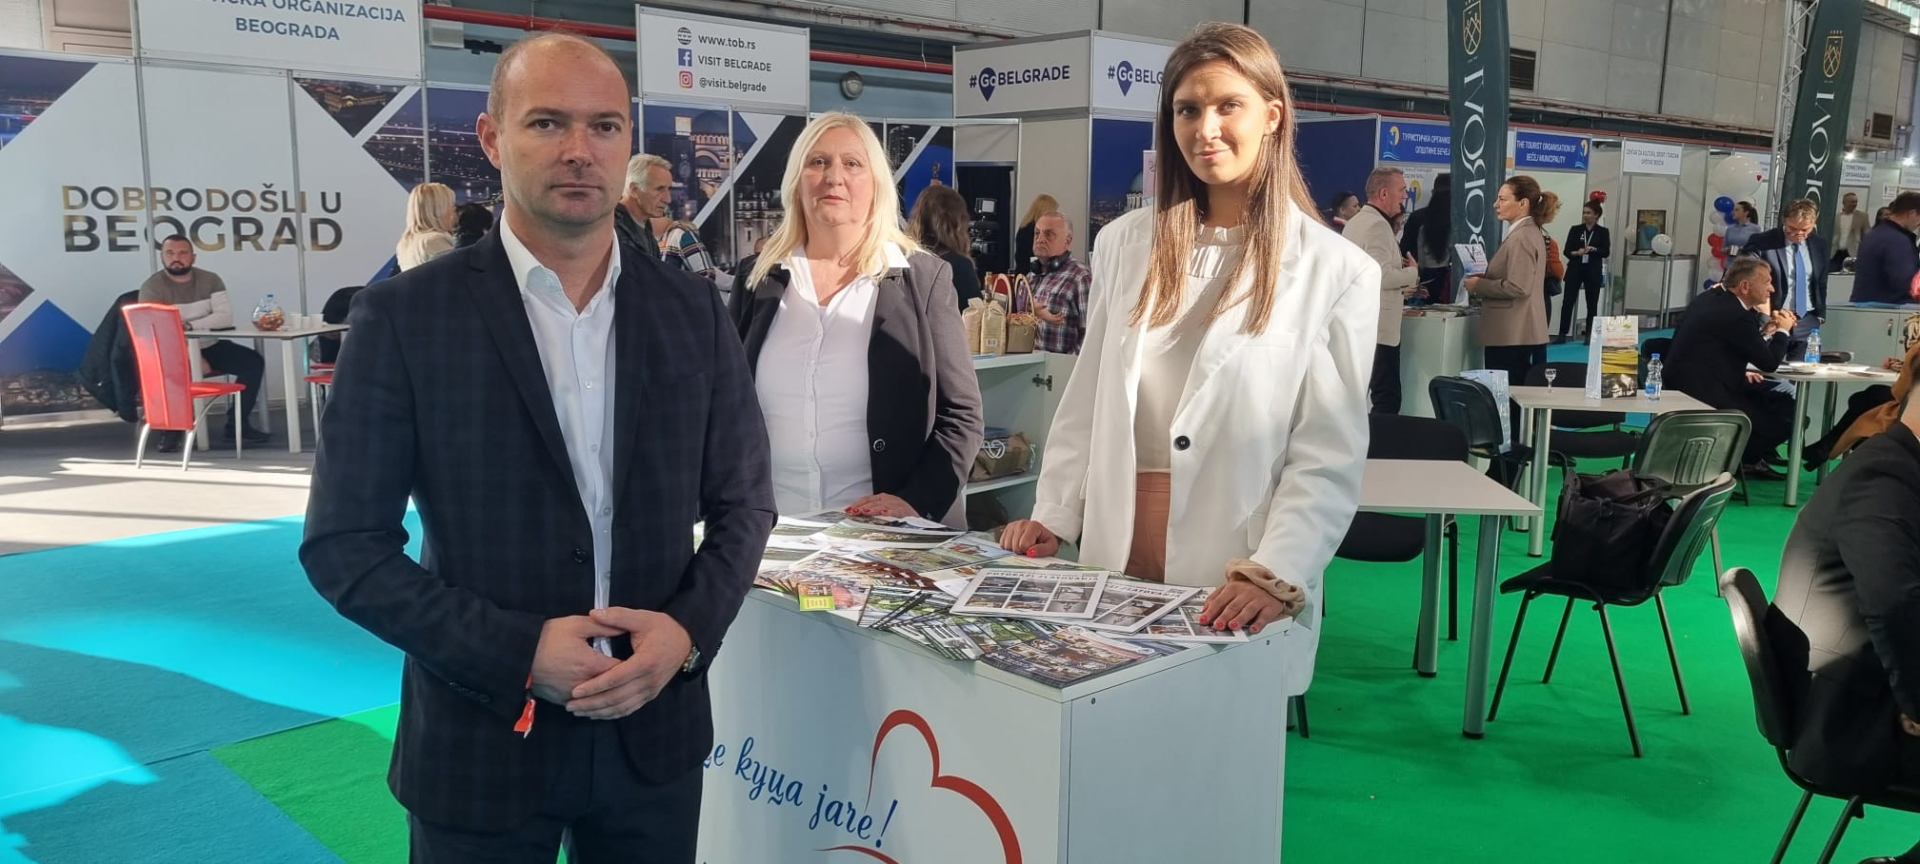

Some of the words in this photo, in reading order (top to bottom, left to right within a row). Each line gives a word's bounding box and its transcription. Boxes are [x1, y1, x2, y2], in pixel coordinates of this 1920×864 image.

[273, 0, 405, 22] ORGANIZACIJA
[235, 17, 340, 40] BEOGRADA
[698, 35, 756, 50] www.tob.rs
[698, 55, 722, 67] VISIT
[724, 58, 772, 72] BELGRADE
[699, 77, 767, 92] @visit.belgrade
[1516, 140, 1525, 149] THE
[1526, 141, 1542, 150] TOURIST
[62, 183, 307, 213] DOBRODOŠLI
[321, 191, 341, 214] U
[63, 215, 343, 252] BEOGRAD
